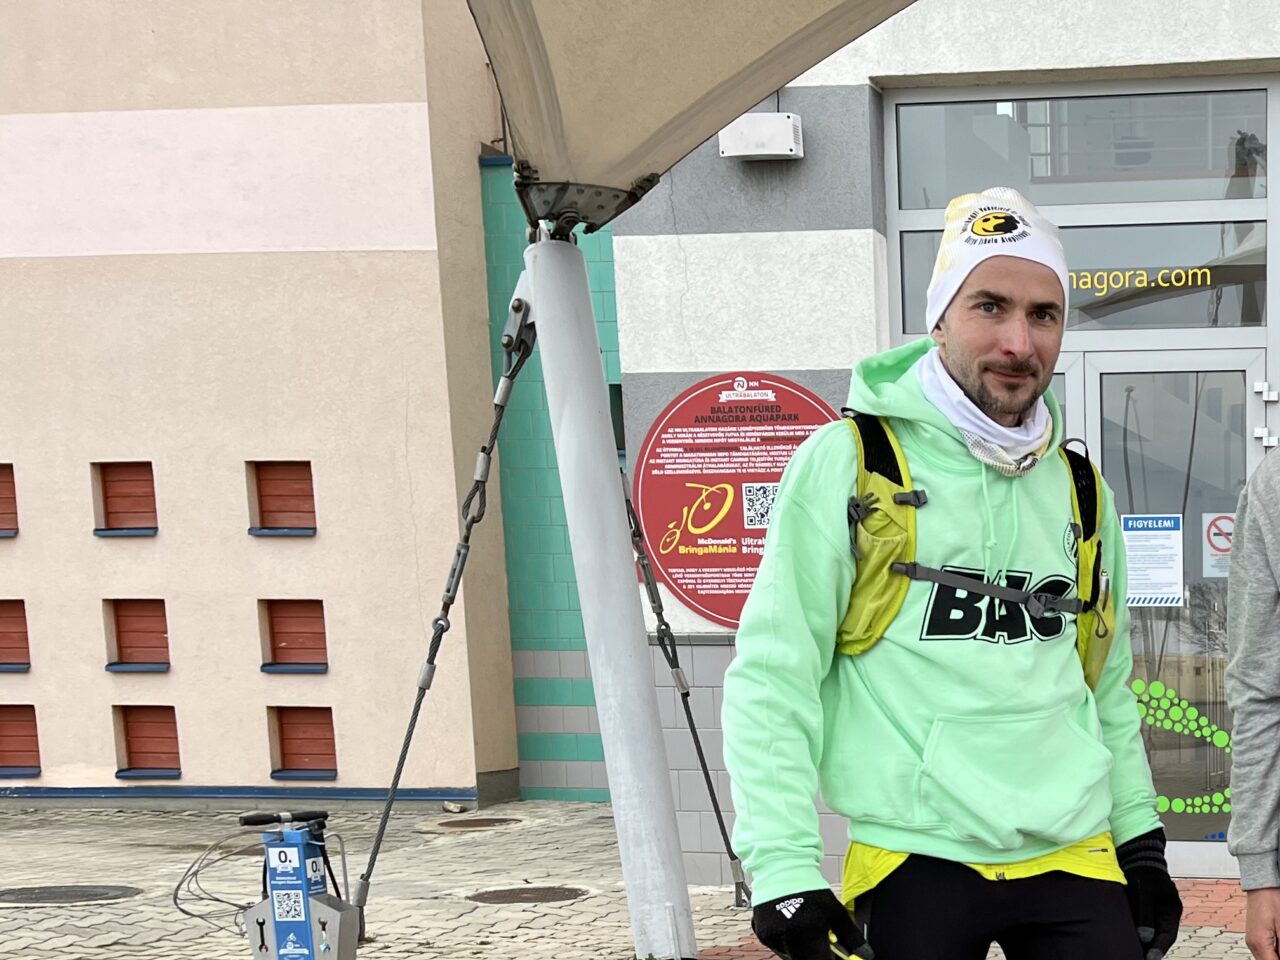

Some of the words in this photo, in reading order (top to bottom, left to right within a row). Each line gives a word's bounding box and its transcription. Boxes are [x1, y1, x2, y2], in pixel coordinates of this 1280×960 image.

[1068, 267, 1211, 296] nagora.com
[710, 404, 782, 414] BALATONFÜRED
[694, 414, 747, 423] ANNAGORA
[749, 413, 800, 423] AQUAPARK
[1128, 520, 1174, 528] FIGYELEM!
[678, 545, 737, 555] BringaMánia
[741, 545, 764, 555] Bring
[278, 850, 292, 864] 0.
[311, 860, 320, 873] 0.
